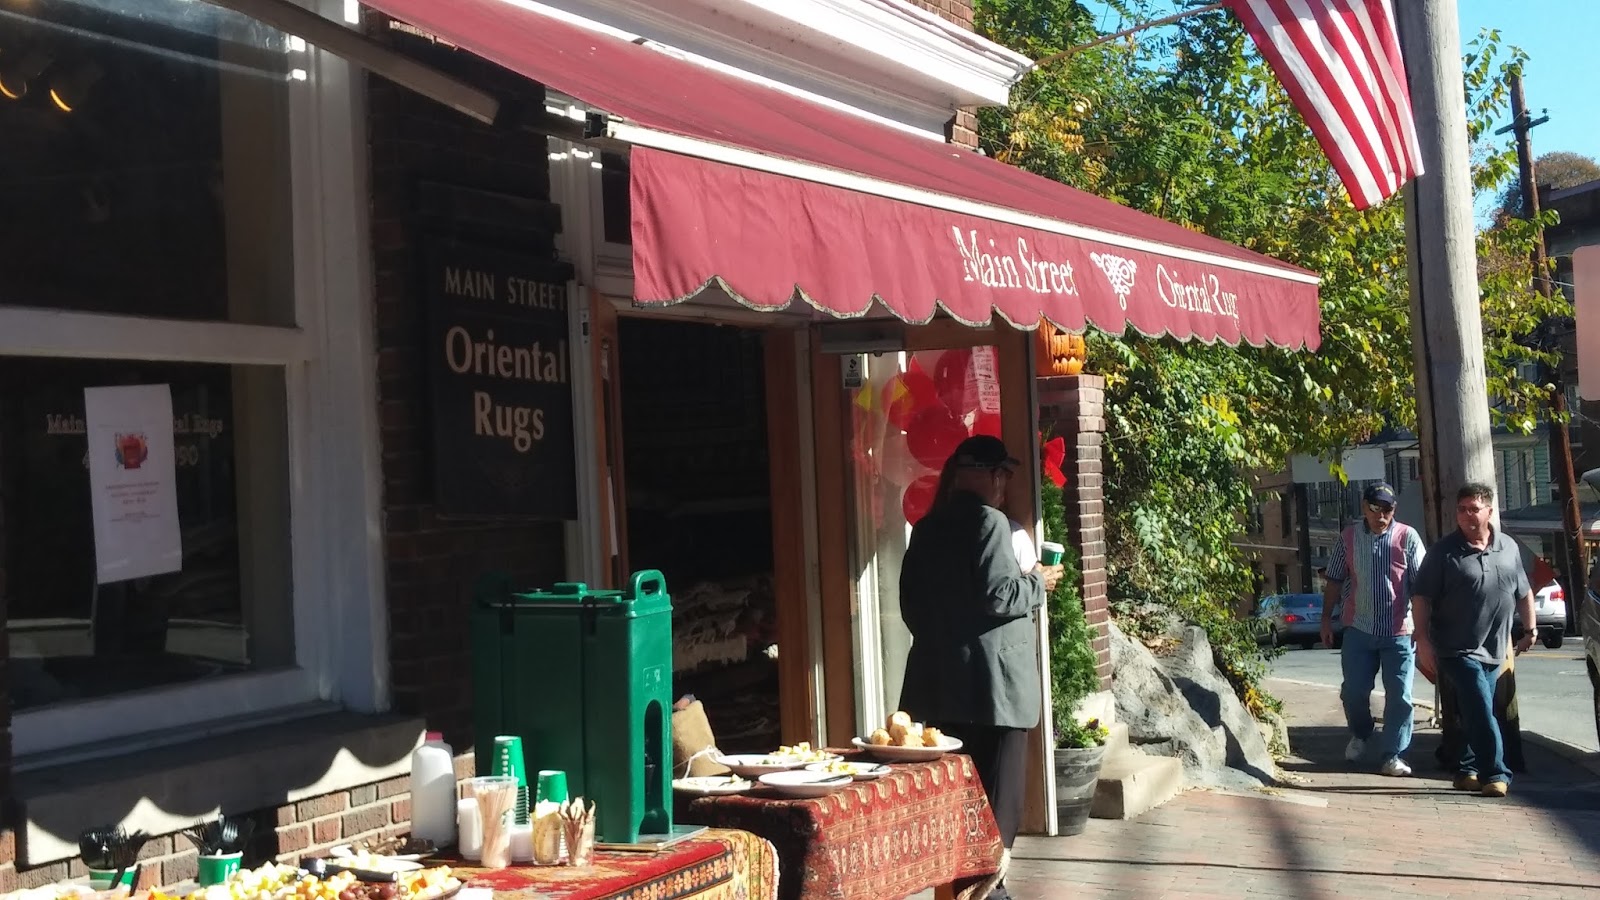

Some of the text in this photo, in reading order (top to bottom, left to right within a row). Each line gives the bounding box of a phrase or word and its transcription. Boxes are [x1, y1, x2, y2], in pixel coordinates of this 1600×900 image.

[445, 266, 566, 311] MAIN STREET
[952, 225, 1079, 297] Main Street
[445, 326, 566, 383] Oriental
[474, 391, 544, 452] Rugs
